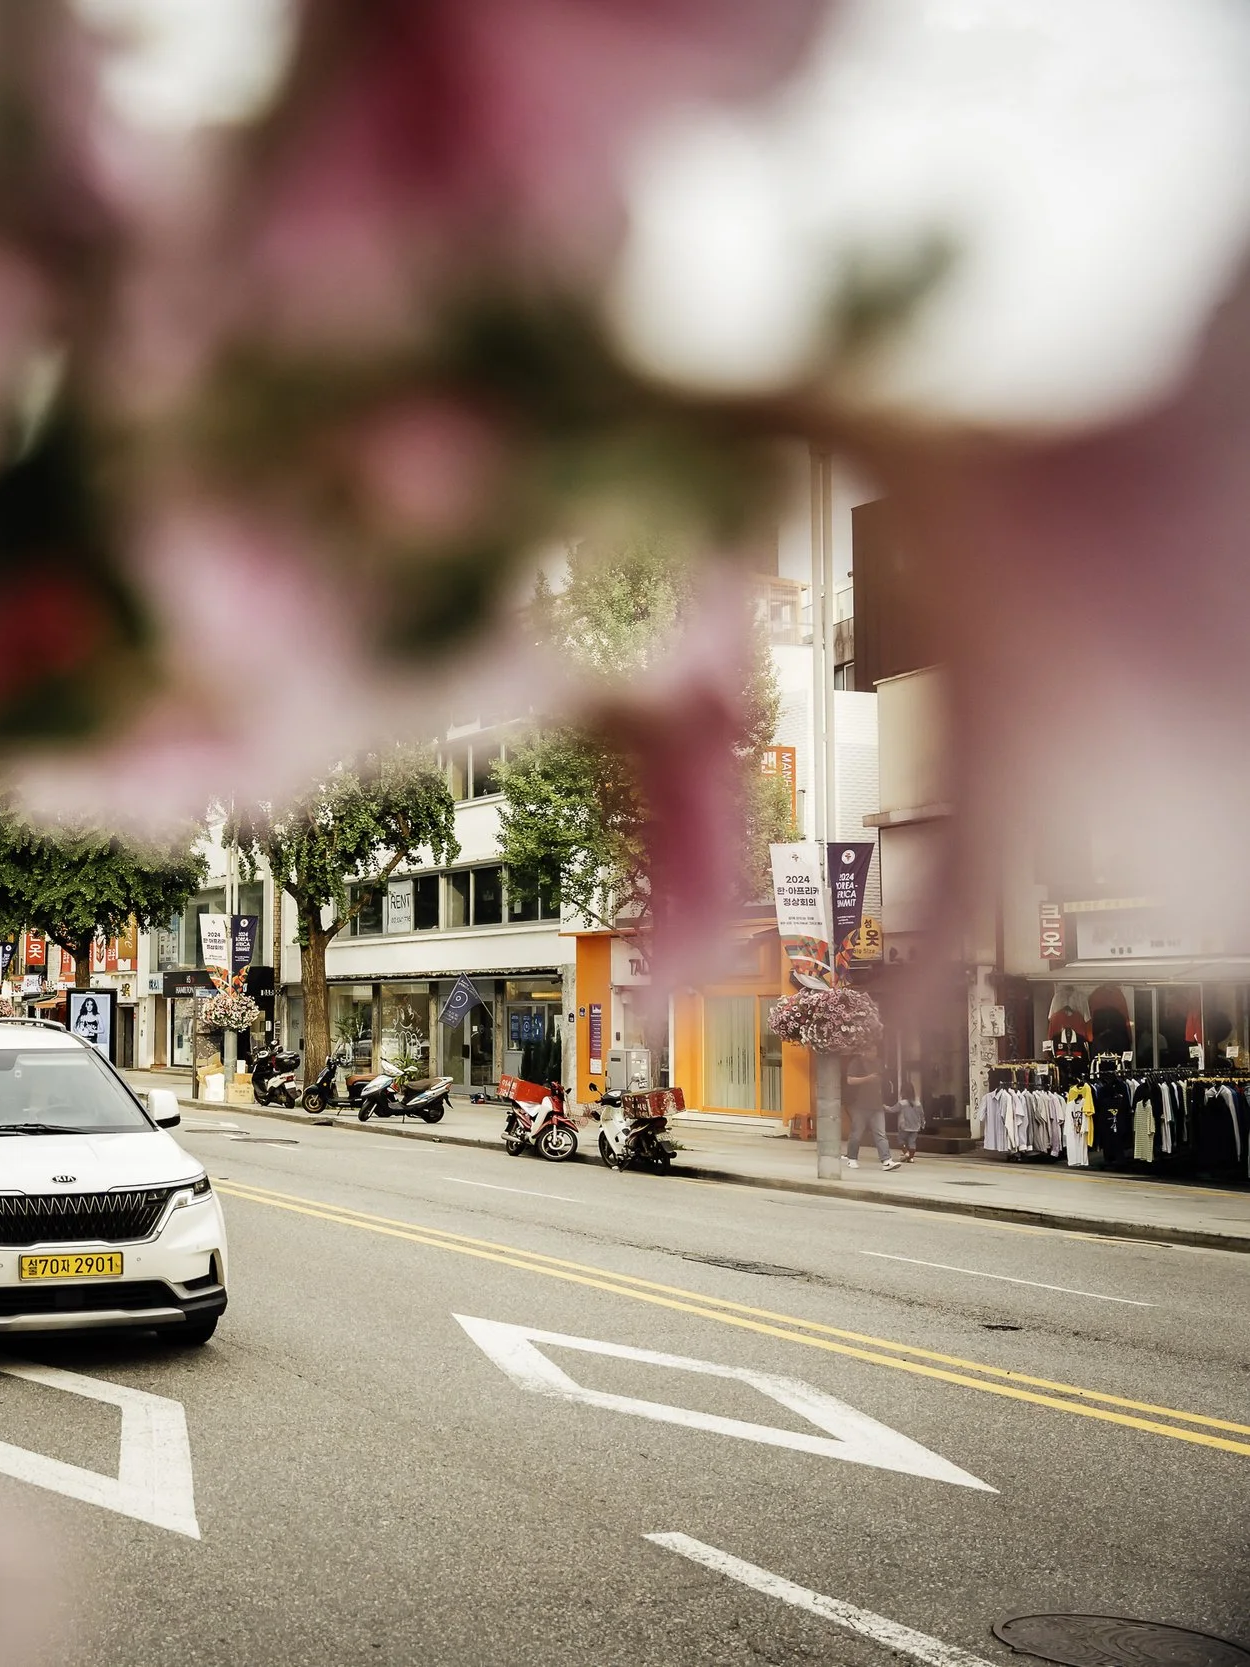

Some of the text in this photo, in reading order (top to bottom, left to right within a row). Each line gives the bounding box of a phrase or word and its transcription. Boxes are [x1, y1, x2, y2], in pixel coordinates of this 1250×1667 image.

[785, 875, 811, 884] 2024
[836, 890, 857, 899] FRICA
[390, 893, 411, 909] RENT
[783, 898, 817, 907] 정상회의
[1041, 904, 1063, 956] 큰옷
[175, 986, 195, 994] HAMILTON
[74, 1256, 114, 1274] 2901
